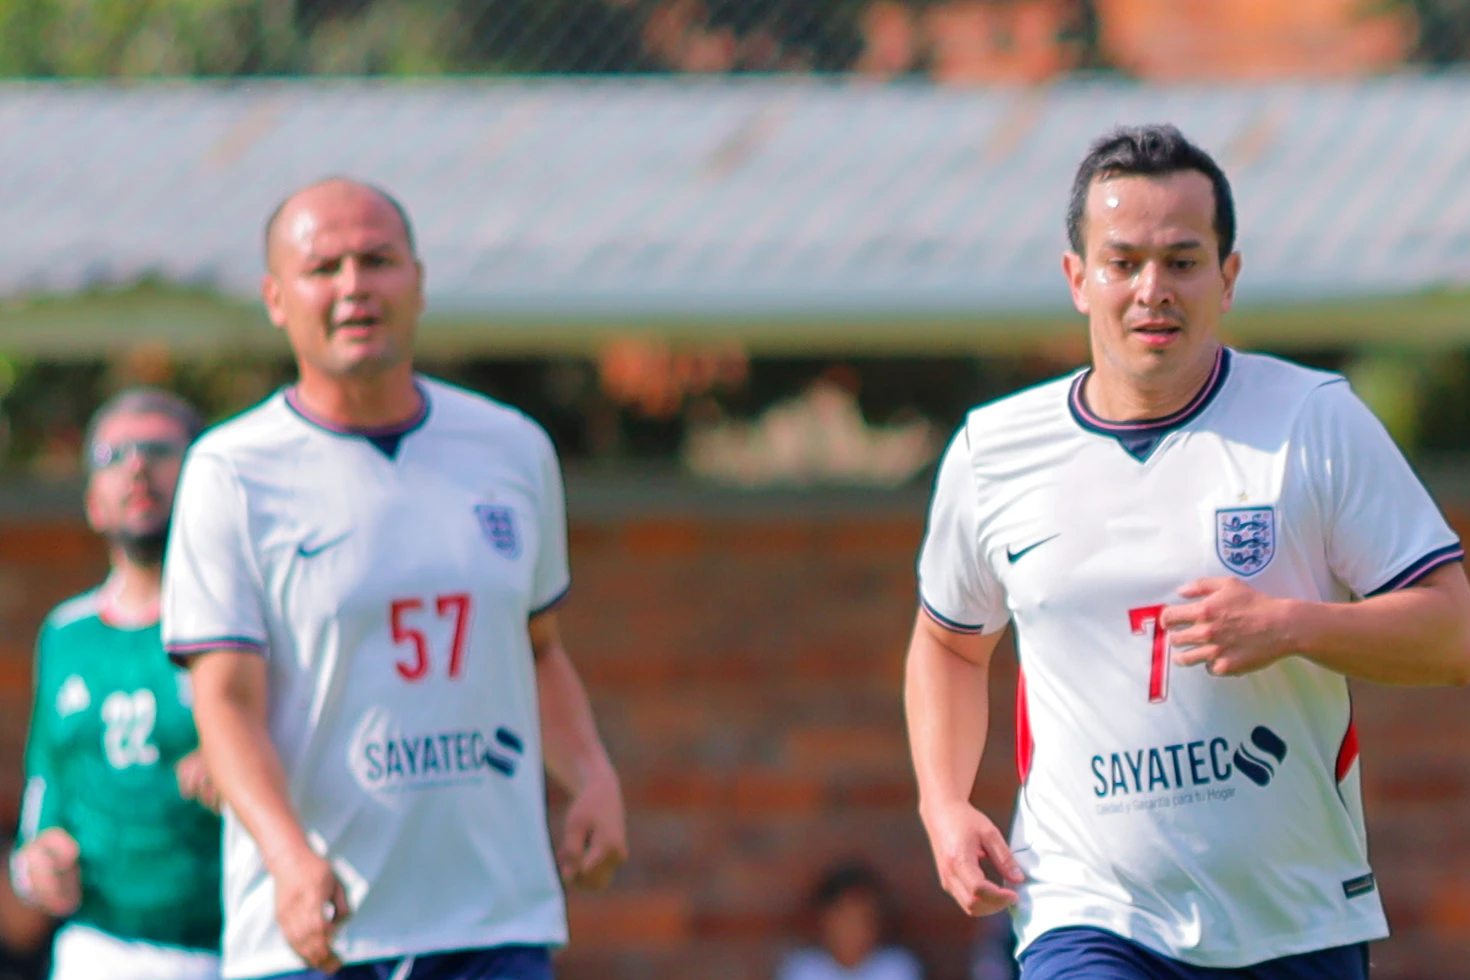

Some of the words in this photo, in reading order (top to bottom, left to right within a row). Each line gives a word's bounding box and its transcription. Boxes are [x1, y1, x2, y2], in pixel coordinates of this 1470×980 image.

[389, 592, 471, 682] 57
[1127, 603, 1171, 704] 7
[101, 687, 160, 770] 22
[365, 731, 486, 780] SAYATEC
[1091, 736, 1233, 798] SAYATEC
